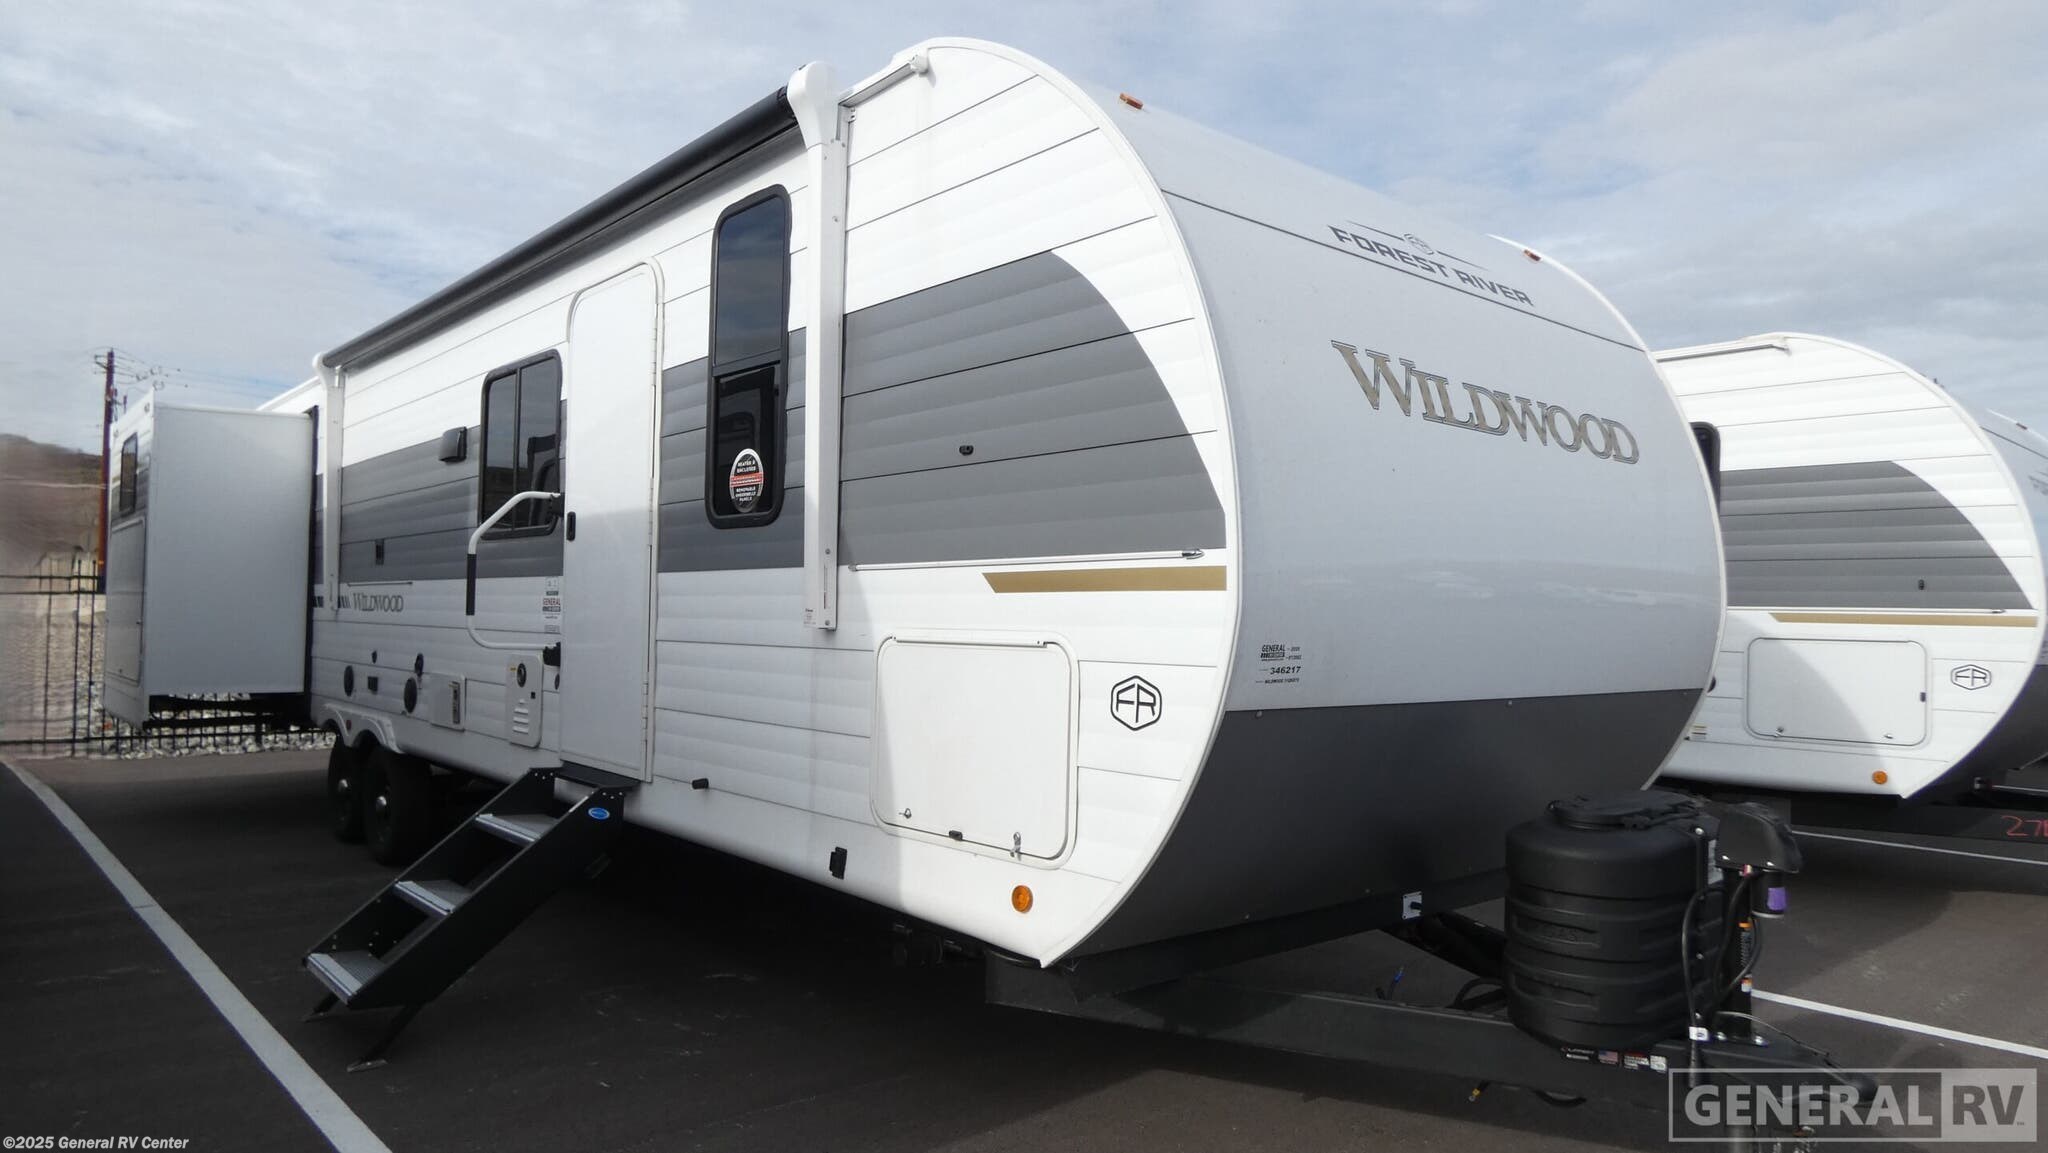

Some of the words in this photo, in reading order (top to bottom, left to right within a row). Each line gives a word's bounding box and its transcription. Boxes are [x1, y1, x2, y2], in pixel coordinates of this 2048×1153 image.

[1327, 225, 1449, 278] FOREST
[1451, 267, 1535, 307] RIVER
[1330, 339, 1640, 465] WILDWOOD
[1270, 666, 1301, 674] 346217
